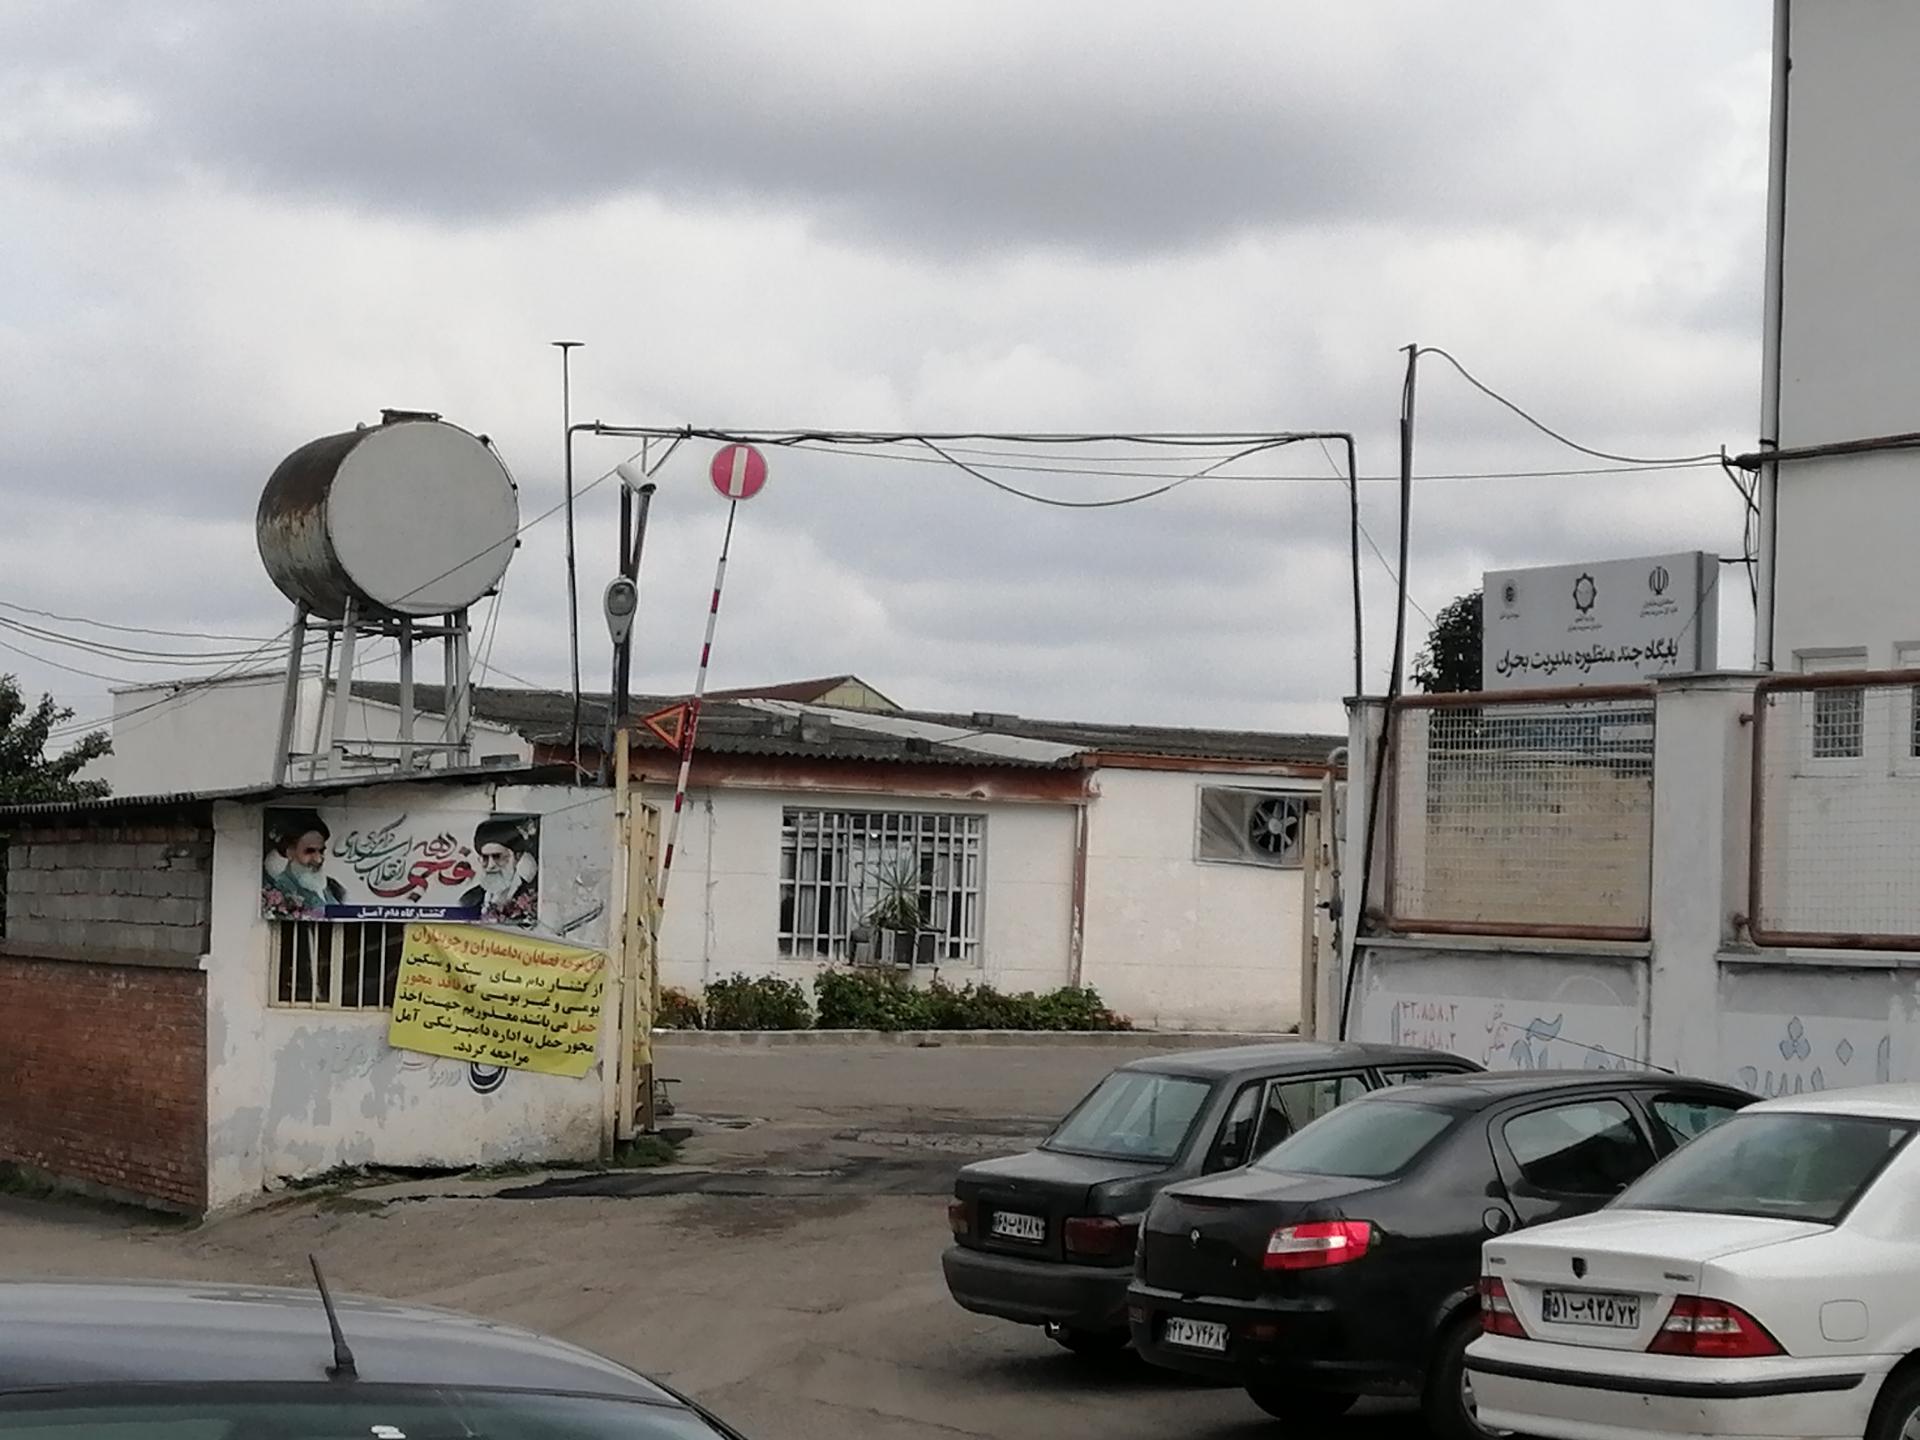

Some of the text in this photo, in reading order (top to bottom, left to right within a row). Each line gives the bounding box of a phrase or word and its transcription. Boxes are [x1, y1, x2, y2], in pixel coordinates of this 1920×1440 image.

[1496, 638, 1679, 677] پایگاه چند منظوره مدیریت بحران
[367, 847, 476, 903] فجر
[357, 906, 383, 918] آمل
[384, 908, 400, 918] دام
[406, 952, 604, 996] از کشتار دام های سبک و سنگین
[462, 983, 477, 994] که
[480, 990, 520, 1007] بومی
[524, 994, 551, 1011] غیر
[395, 1008, 420, 1024] آمل
[399, 988, 597, 1034] حمل می باشند معذوریم جهت اخذ
[552, 1003, 560, 1014] و
[562, 1001, 600, 1019] بومی
[423, 1015, 491, 1038] دامپزشکی
[492, 1027, 520, 1045] اداره
[522, 1033, 534, 1046] به
[534, 1032, 563, 1049] حمل
[489, 1047, 530, 1066] مراجعه
